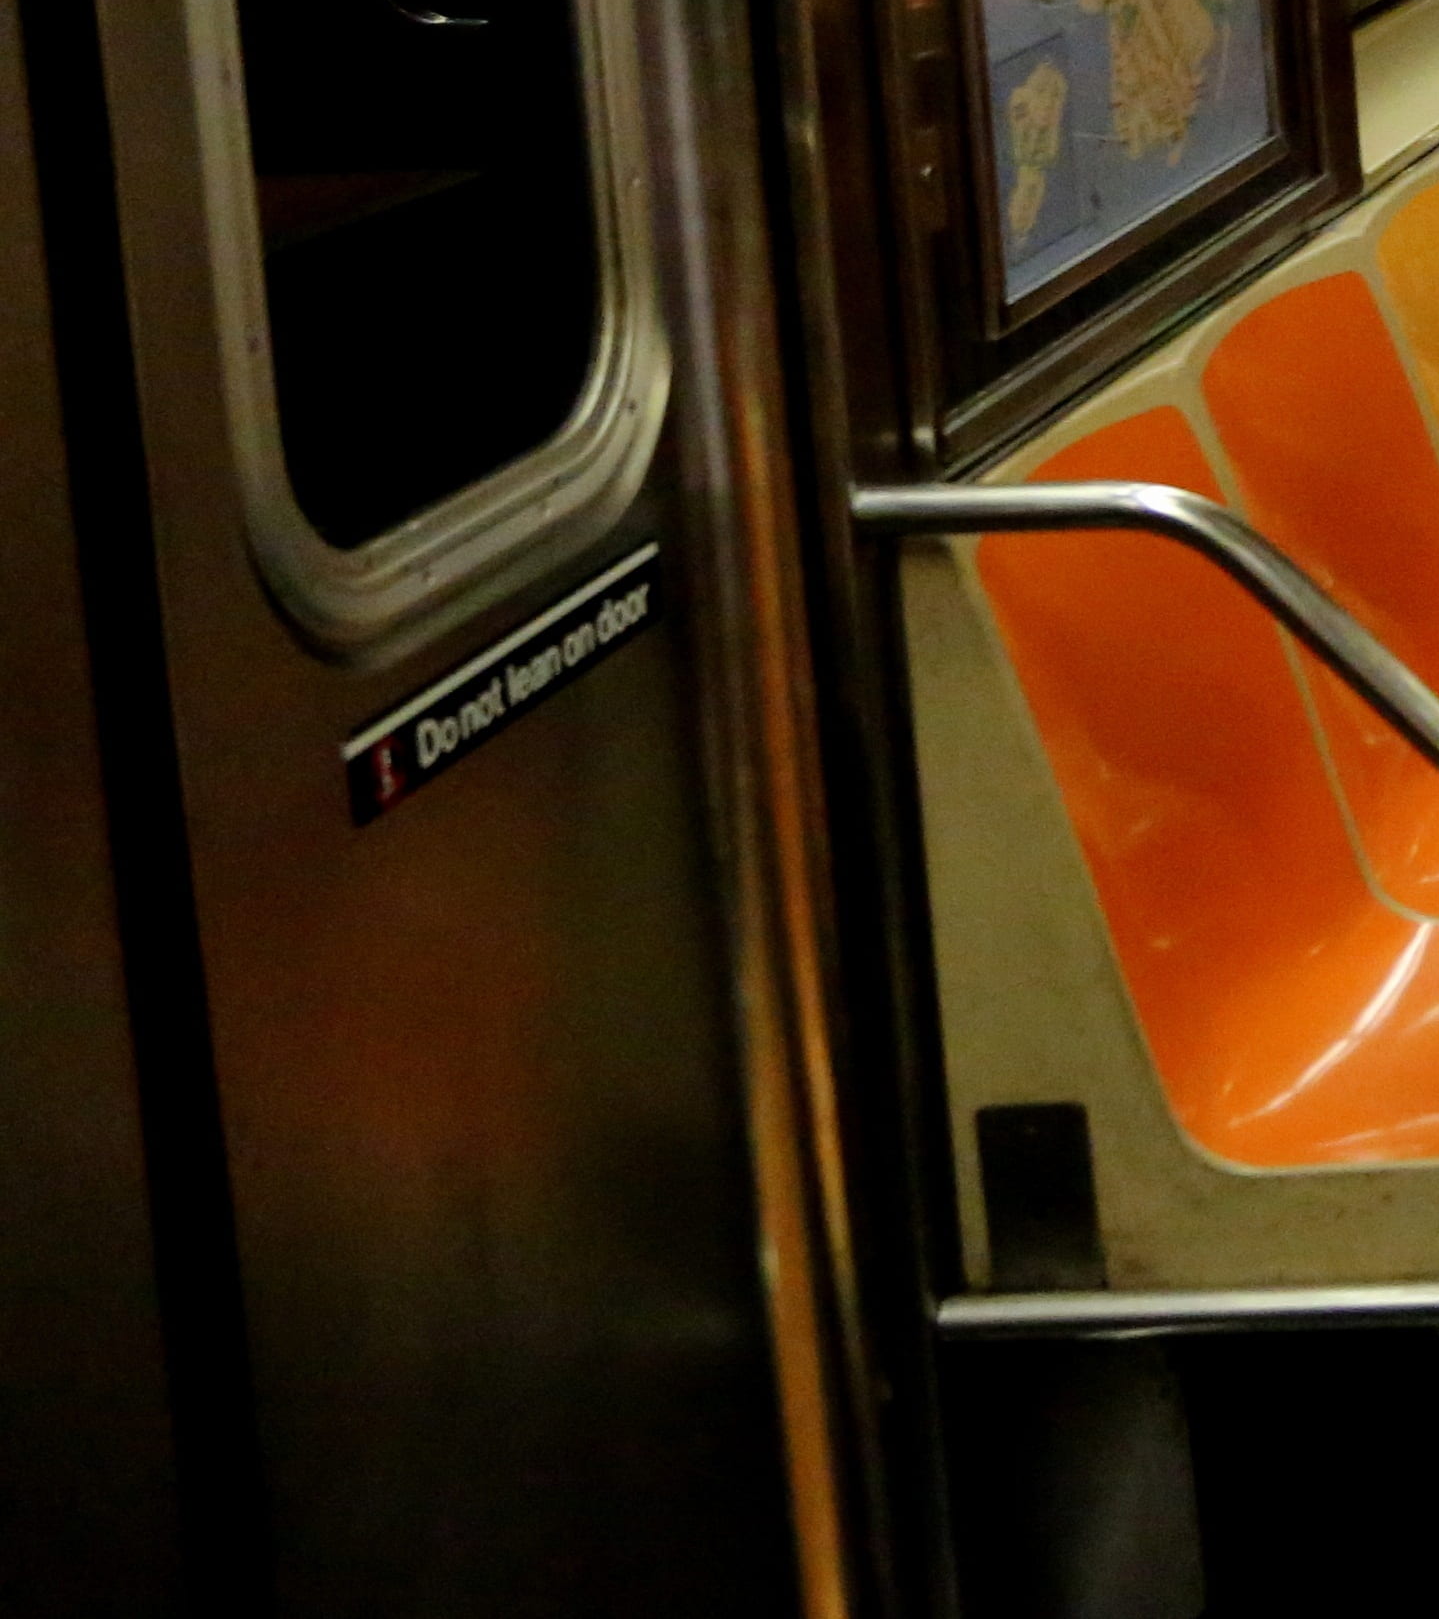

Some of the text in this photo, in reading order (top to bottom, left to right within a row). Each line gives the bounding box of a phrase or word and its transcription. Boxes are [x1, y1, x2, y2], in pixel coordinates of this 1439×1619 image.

[414, 582, 650, 769] Do not lean on door
